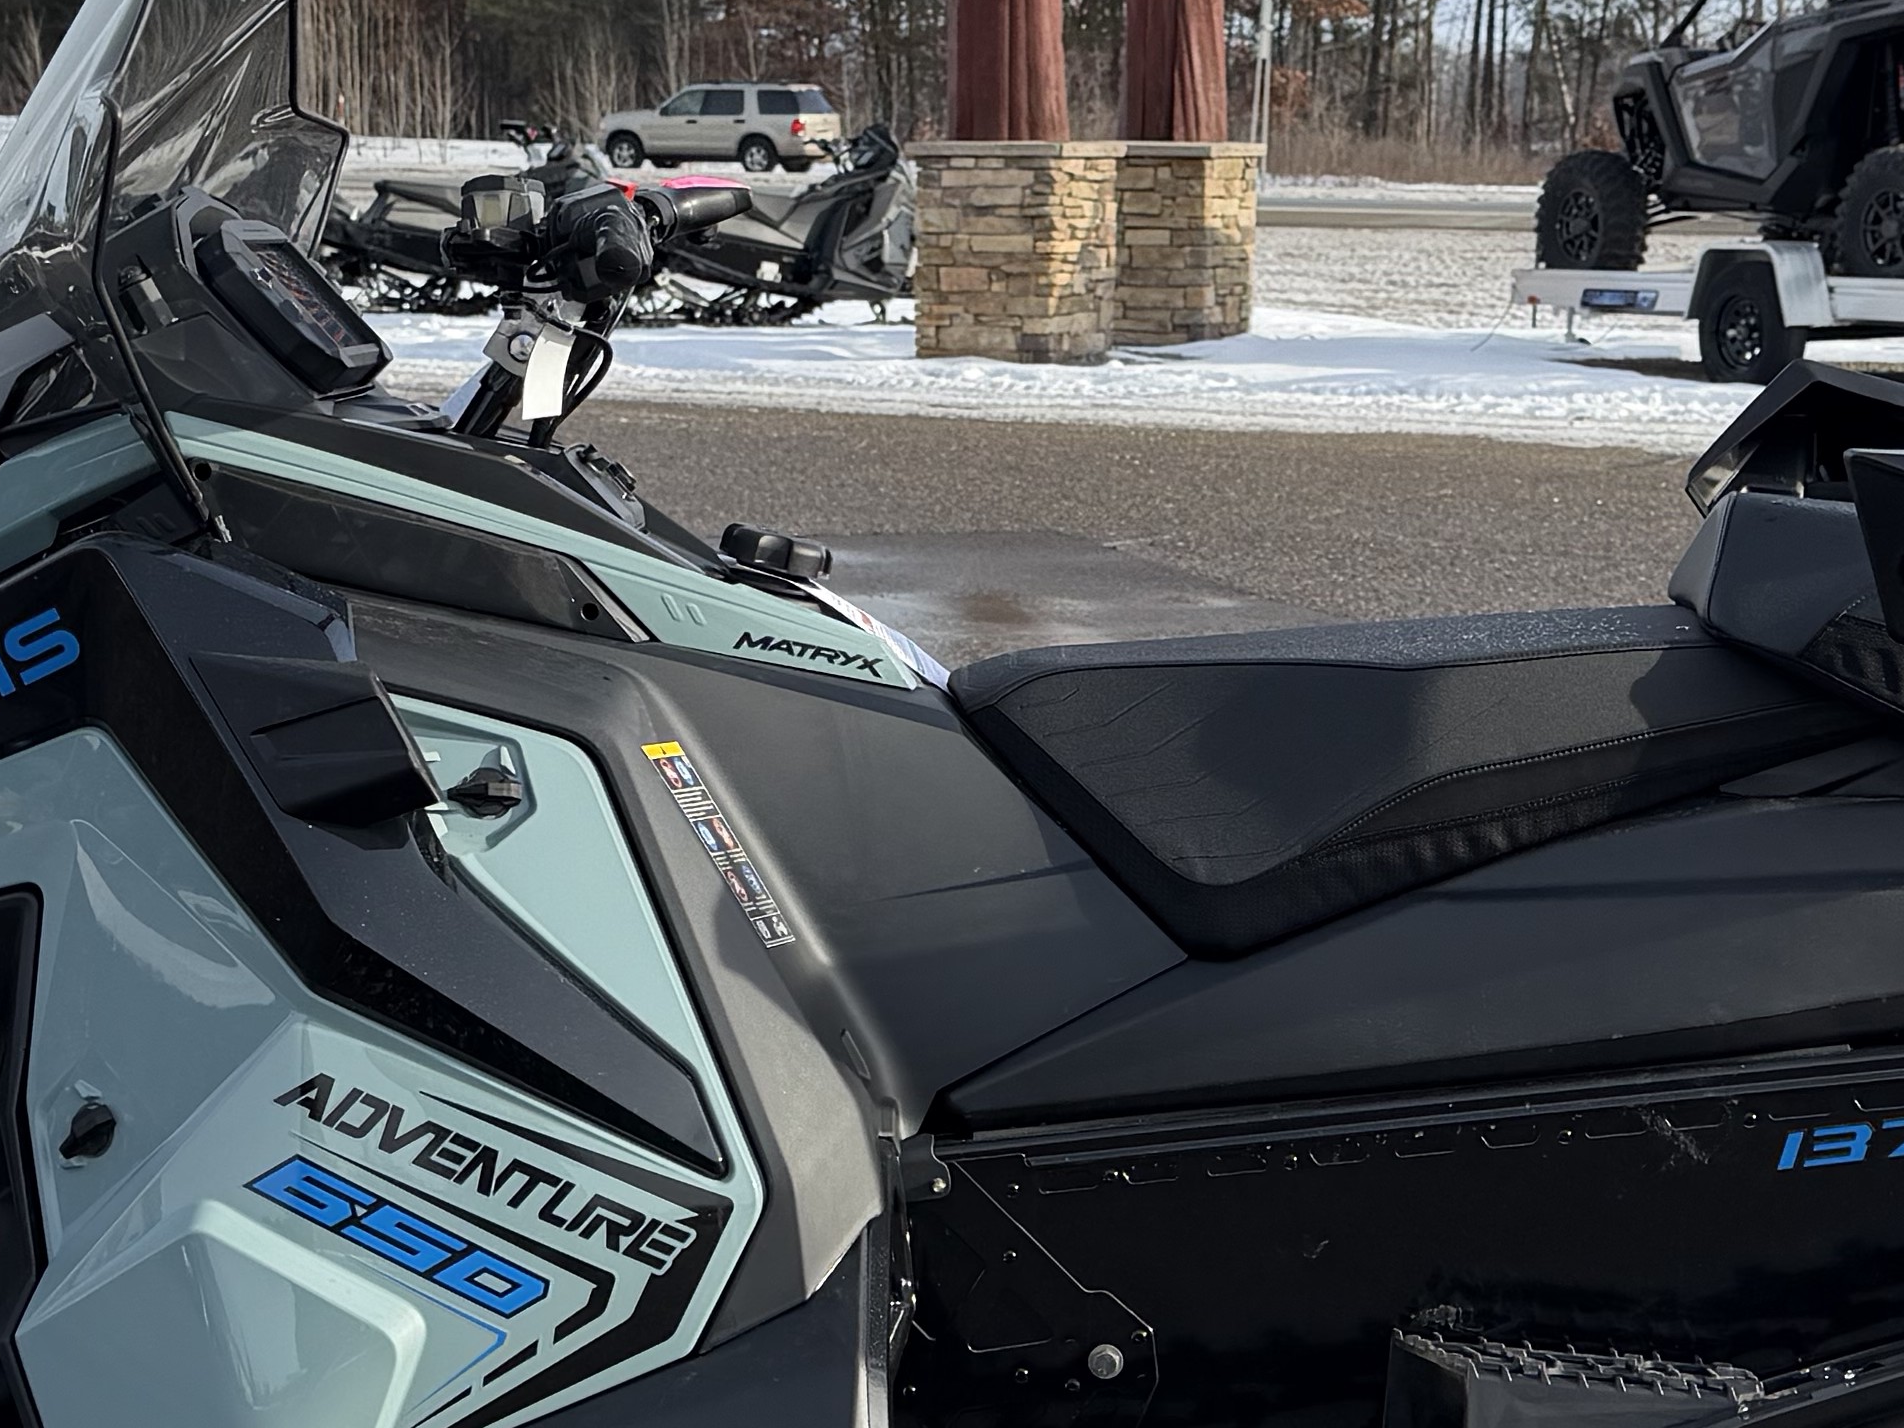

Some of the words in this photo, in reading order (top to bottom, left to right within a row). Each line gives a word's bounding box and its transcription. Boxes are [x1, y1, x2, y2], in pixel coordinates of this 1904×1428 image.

[733, 631, 884, 678] MATRYX
[244, 1154, 550, 1318] 650
[273, 1072, 696, 1271] ADVENTURE
